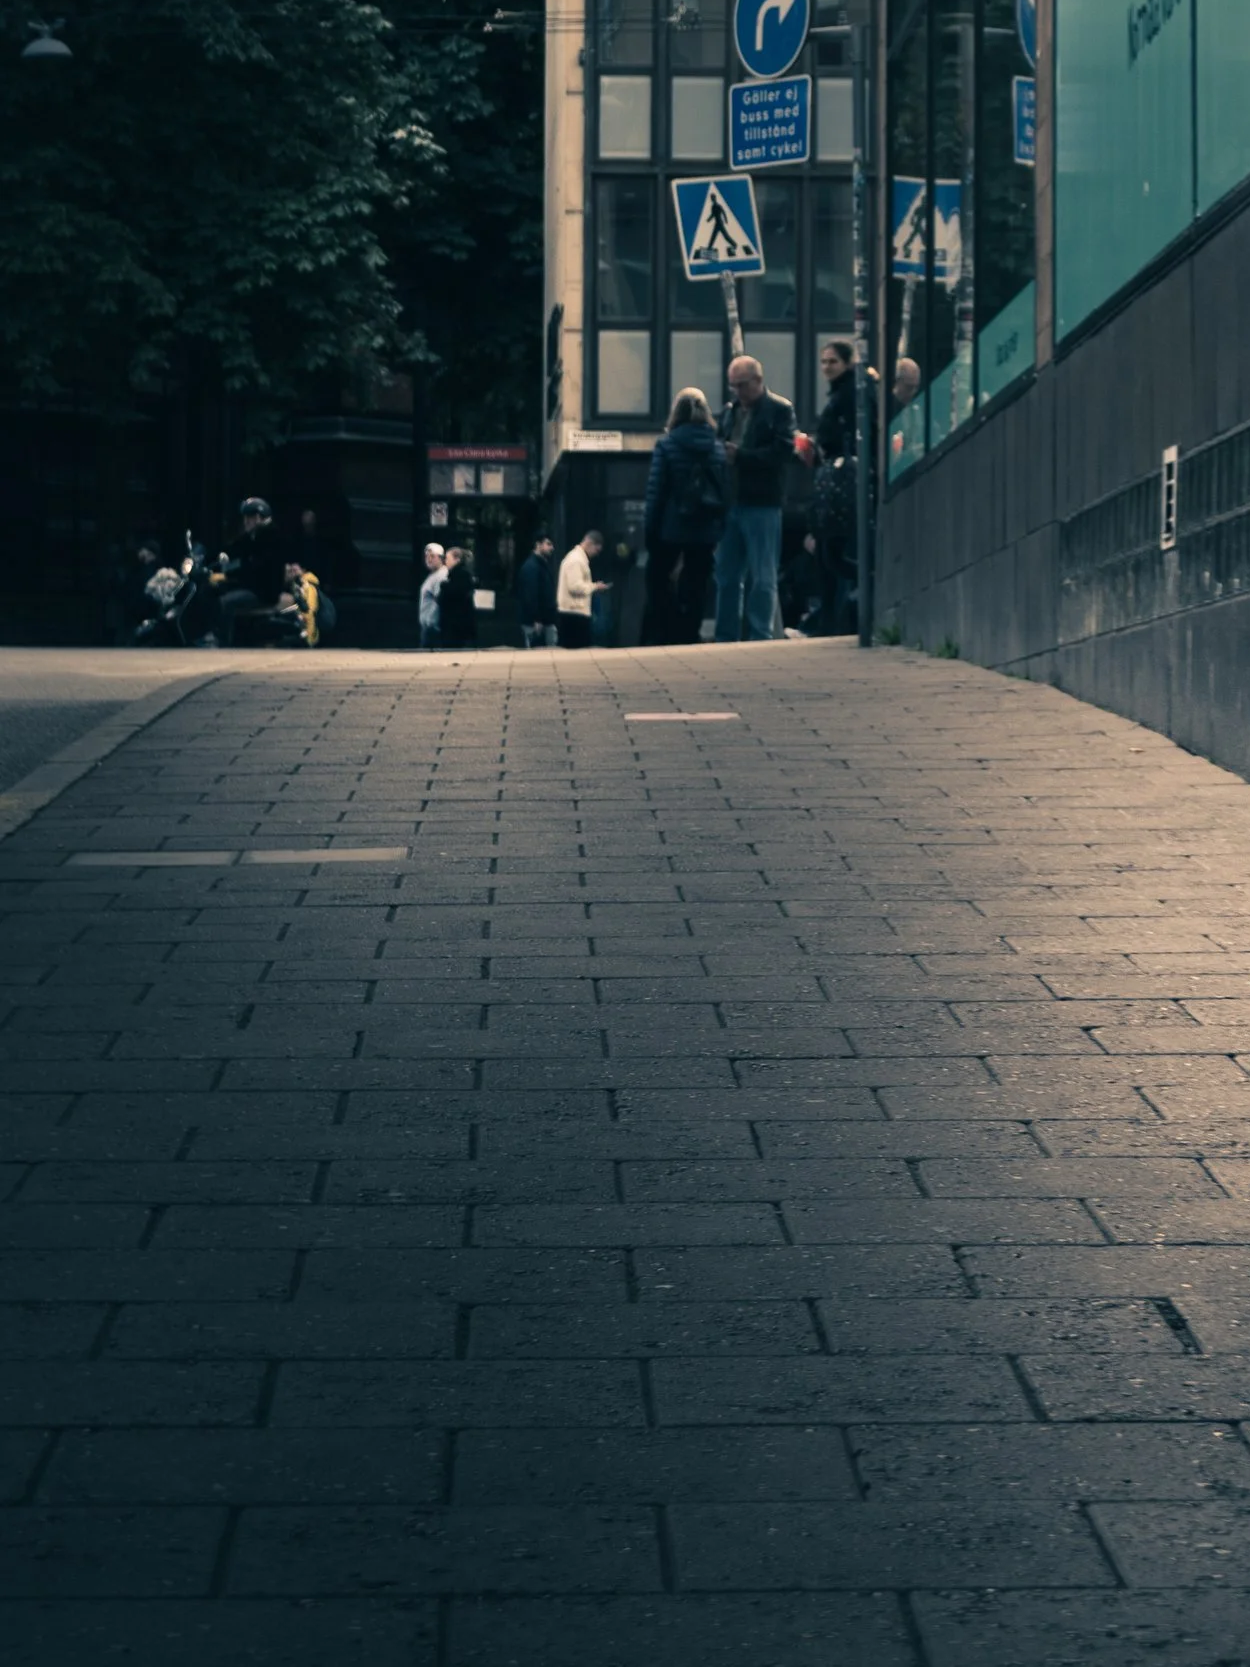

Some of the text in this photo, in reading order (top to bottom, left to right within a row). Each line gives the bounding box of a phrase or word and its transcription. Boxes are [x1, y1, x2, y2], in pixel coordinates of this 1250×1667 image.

[742, 84, 798, 105] Gäller ej
[740, 103, 799, 124] buss med
[743, 123, 795, 140] tillstånd
[737, 140, 802, 160] samt cykel
